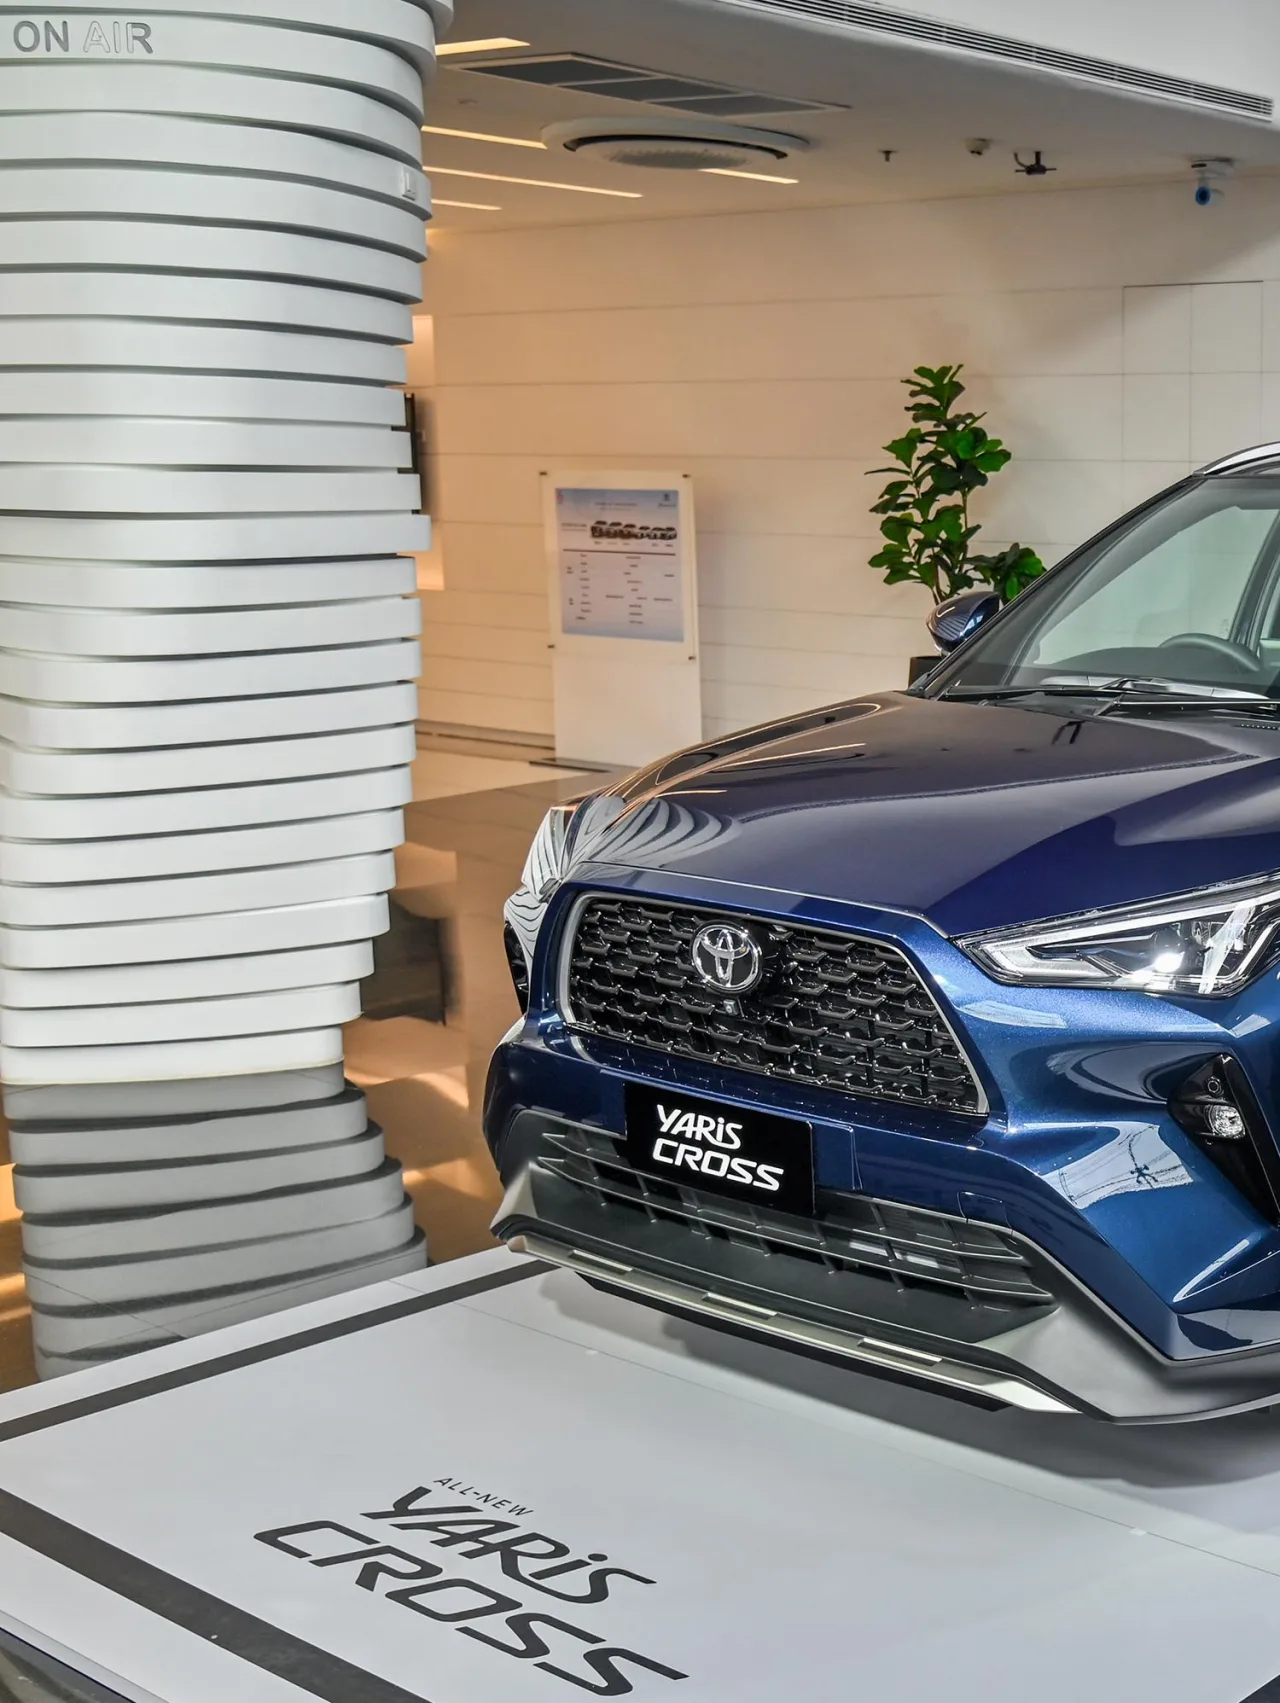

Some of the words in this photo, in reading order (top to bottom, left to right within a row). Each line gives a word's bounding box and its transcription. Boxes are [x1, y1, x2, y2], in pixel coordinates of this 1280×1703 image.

[13, 20, 70, 53] ON
[83, 20, 154, 54] AIR
[652, 1137, 784, 1191] CROSS
[433, 1477, 534, 1516] ALL-NEW
[253, 1520, 690, 1697] CROSS
